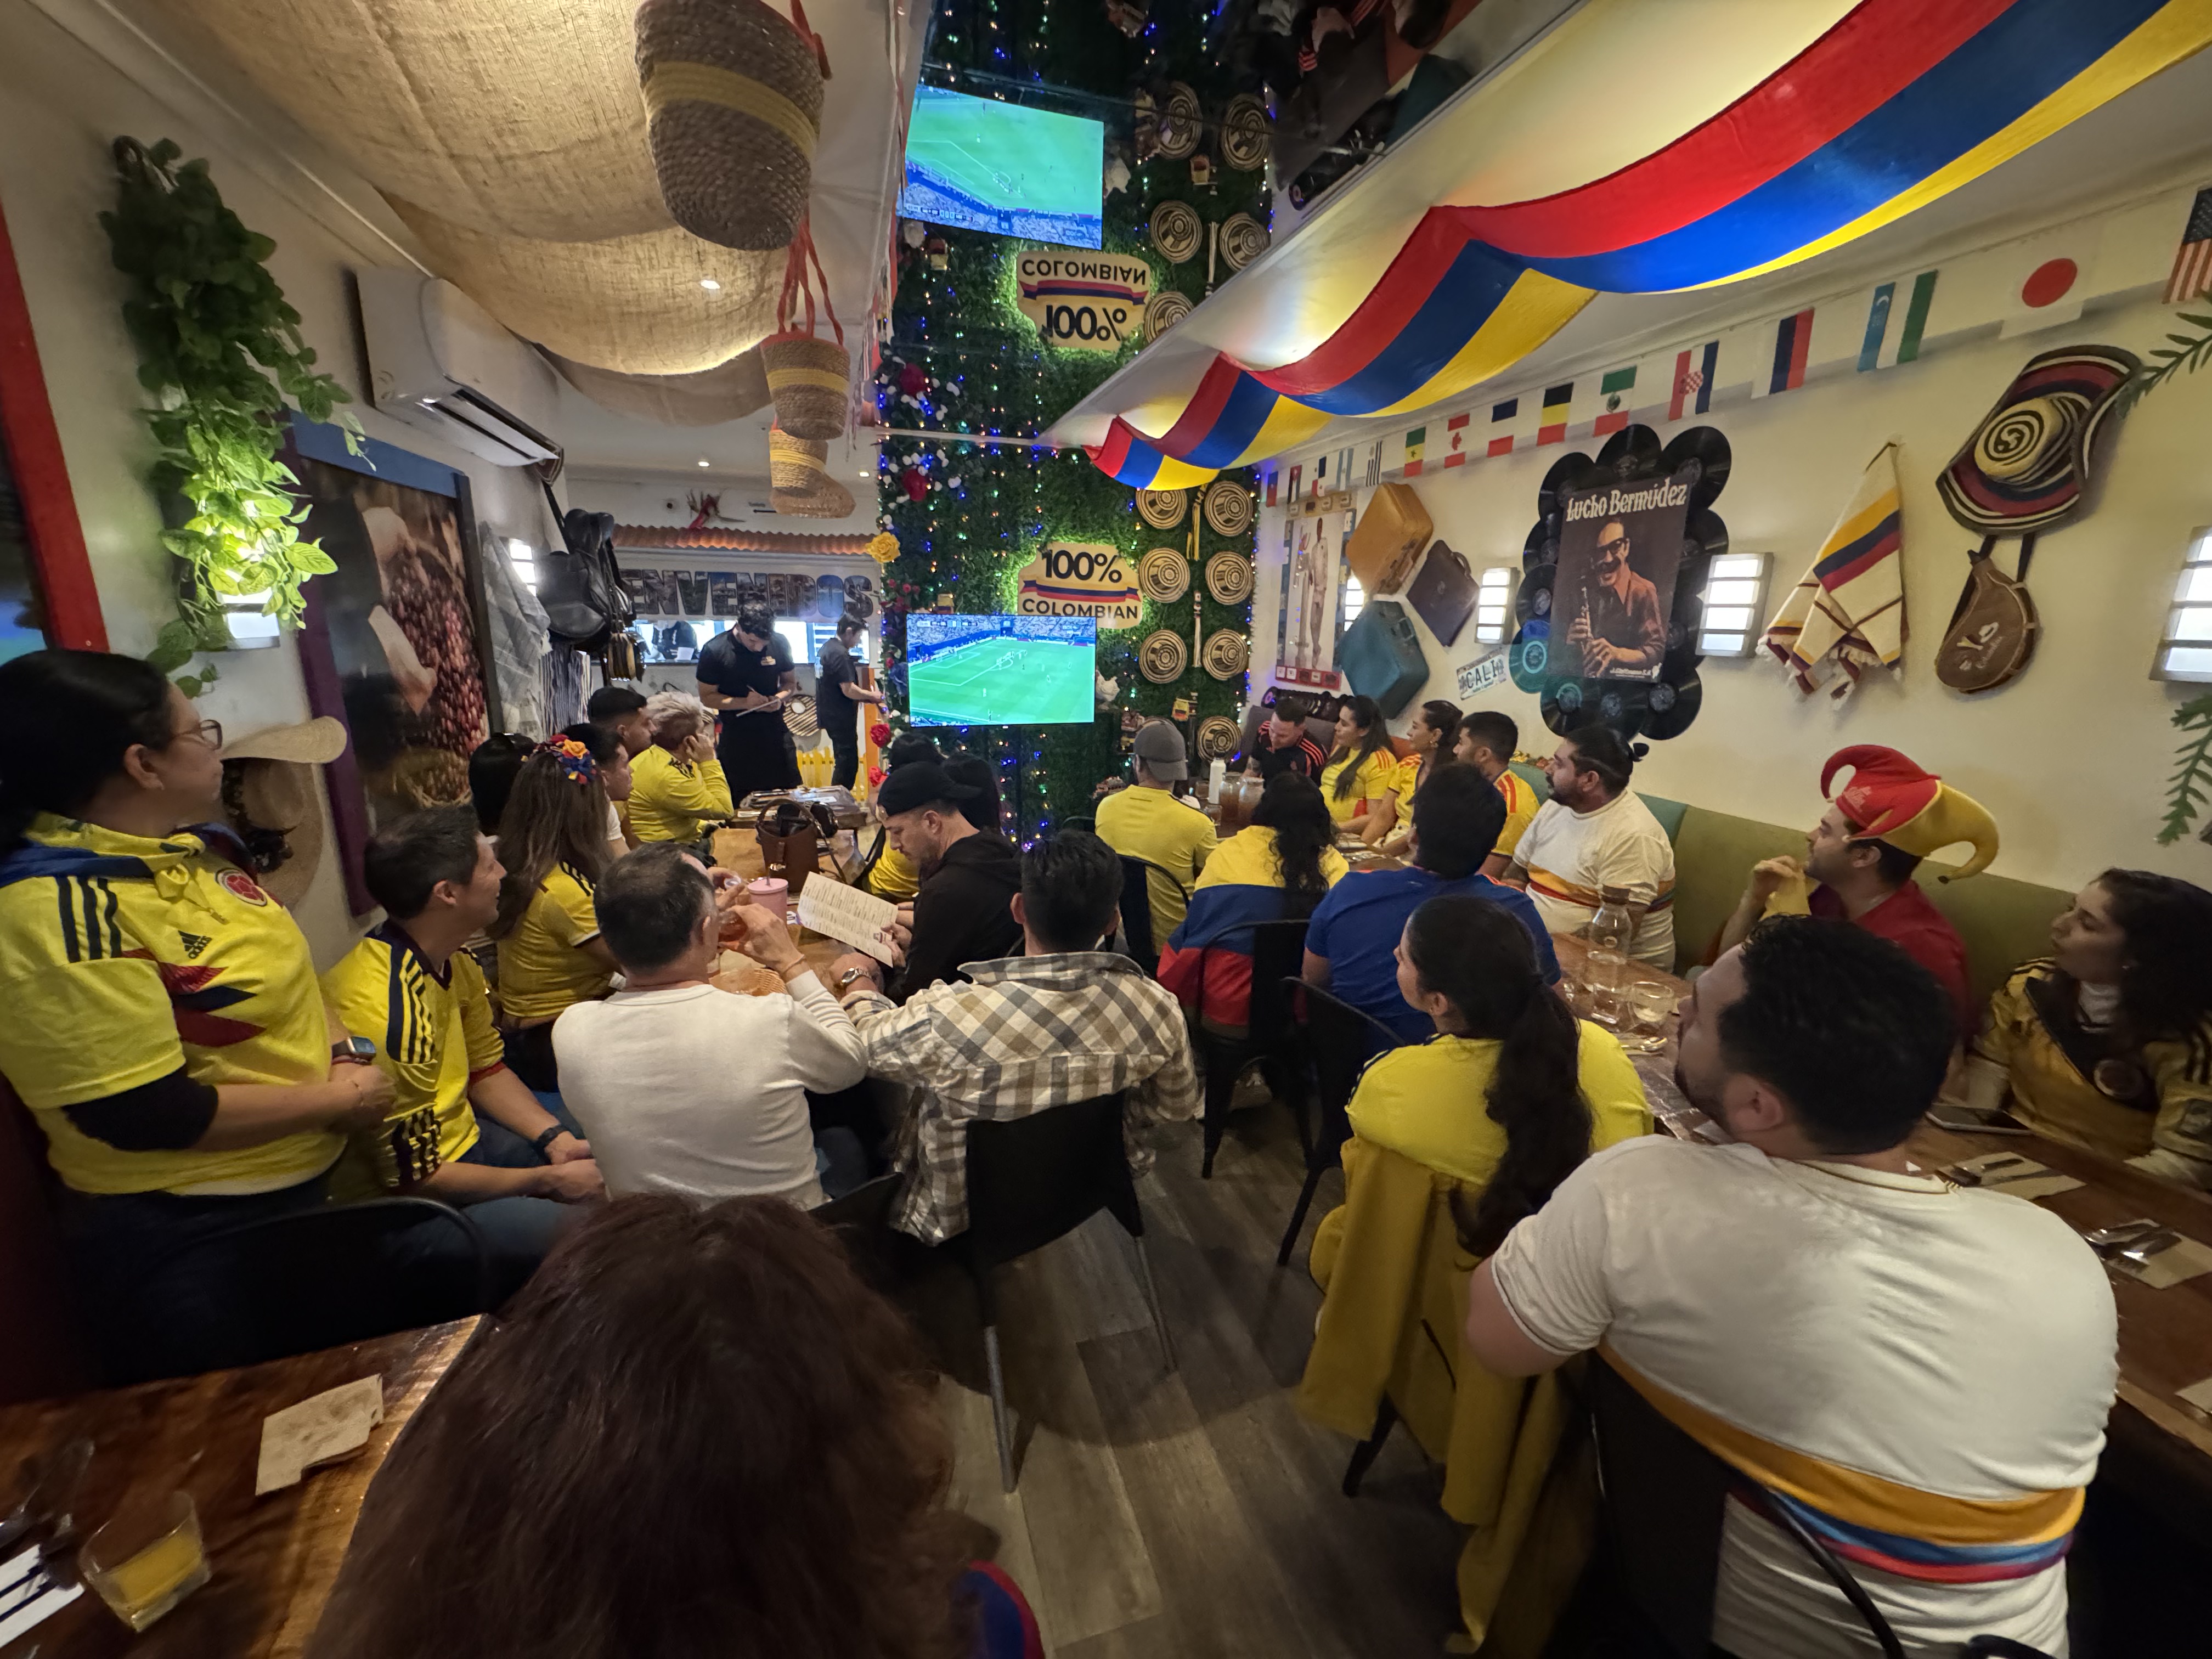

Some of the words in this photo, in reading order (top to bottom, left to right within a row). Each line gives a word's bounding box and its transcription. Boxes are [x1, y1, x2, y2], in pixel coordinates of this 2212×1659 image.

[1566, 498, 1607, 522] Lucho
[1608, 477, 1688, 515] Bermúdez
[1041, 549, 1122, 583] 100%
[619, 569, 874, 618] ENVENIDOS
[1022, 598, 1138, 619] COLOMBIAN
[1466, 659, 1497, 689] CALI
